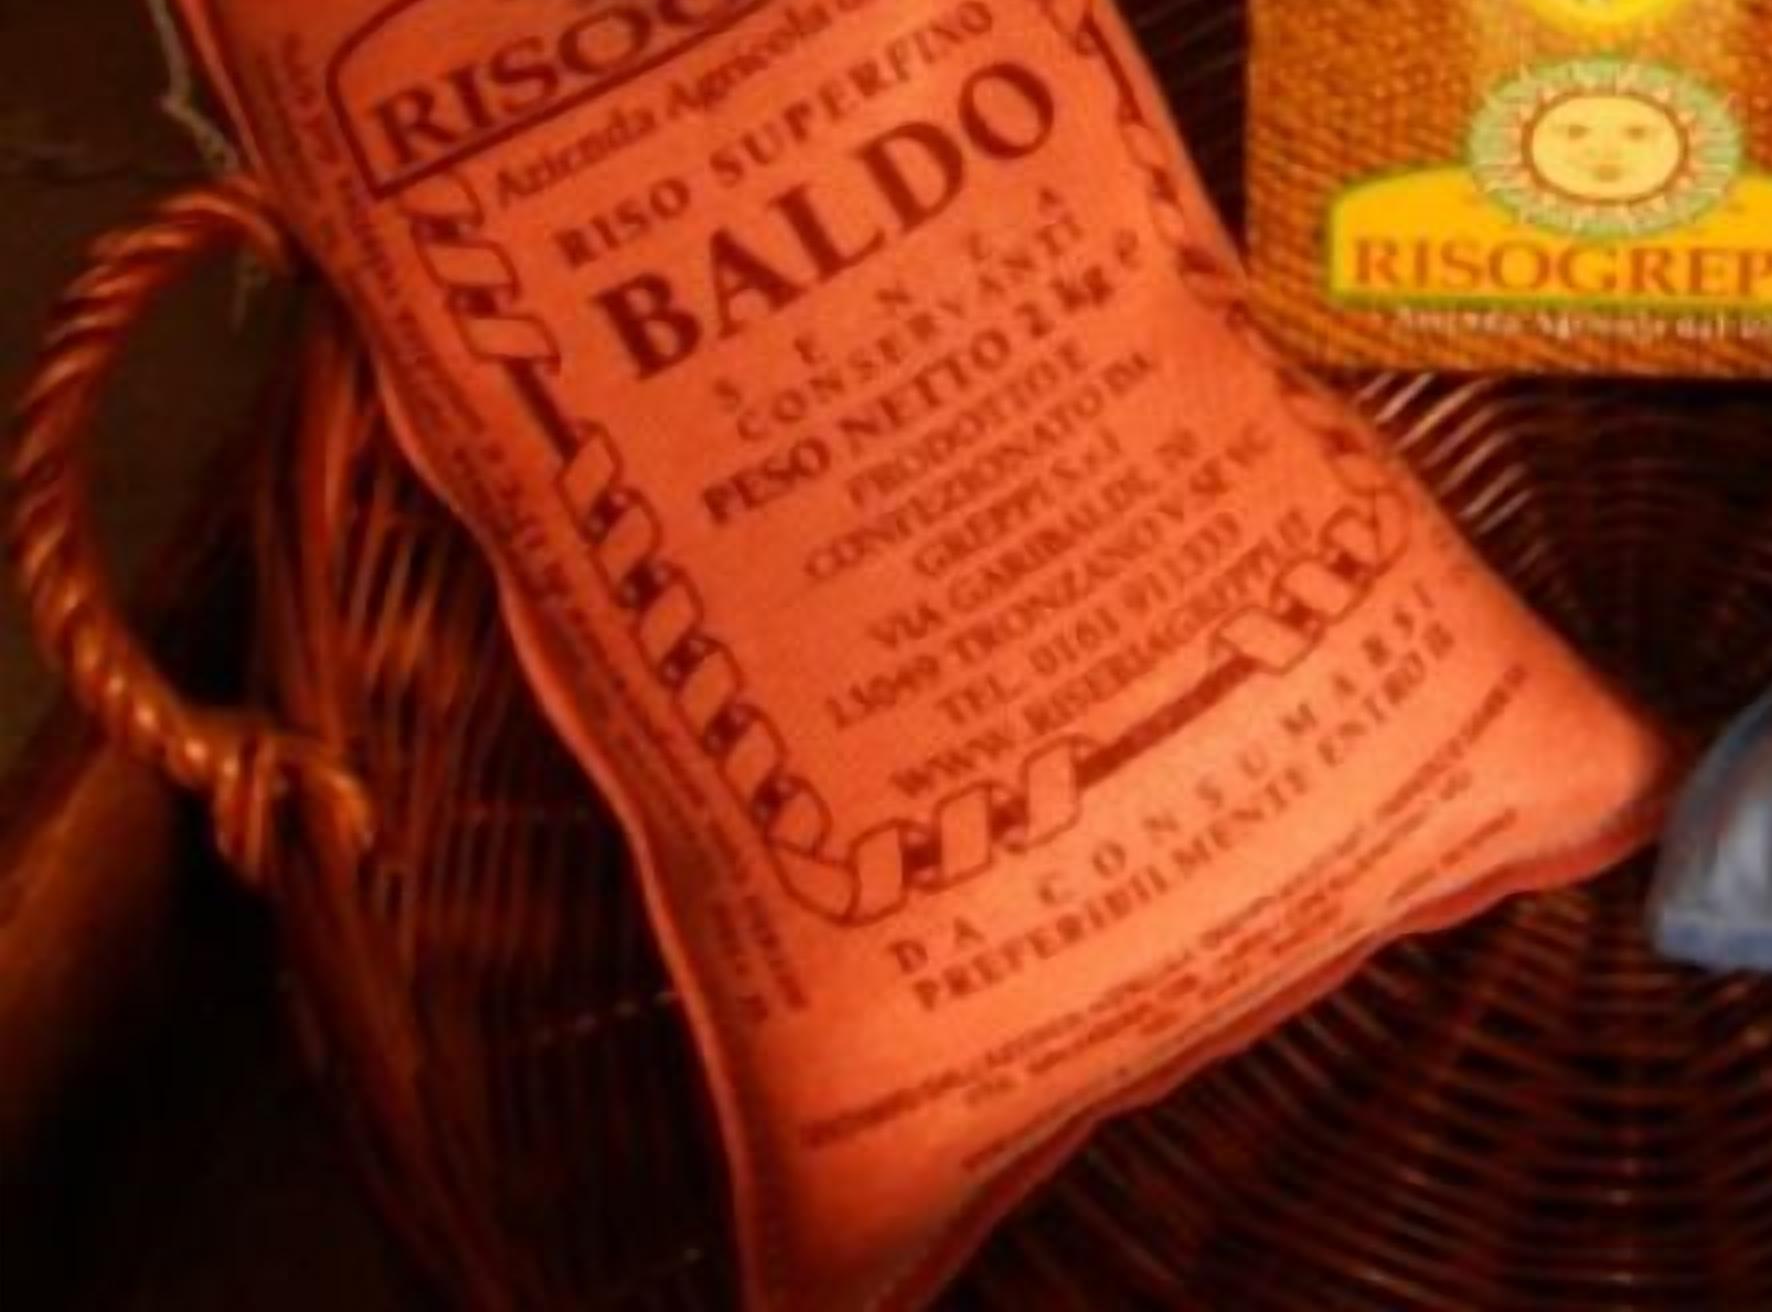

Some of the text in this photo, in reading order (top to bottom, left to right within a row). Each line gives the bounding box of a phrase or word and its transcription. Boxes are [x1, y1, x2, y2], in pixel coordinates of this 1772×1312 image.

[551, 174, 693, 271] RISO
[586, 60, 1057, 382] BALDO
[702, 434, 832, 524] PESO
[836, 328, 1013, 456] NETTO
